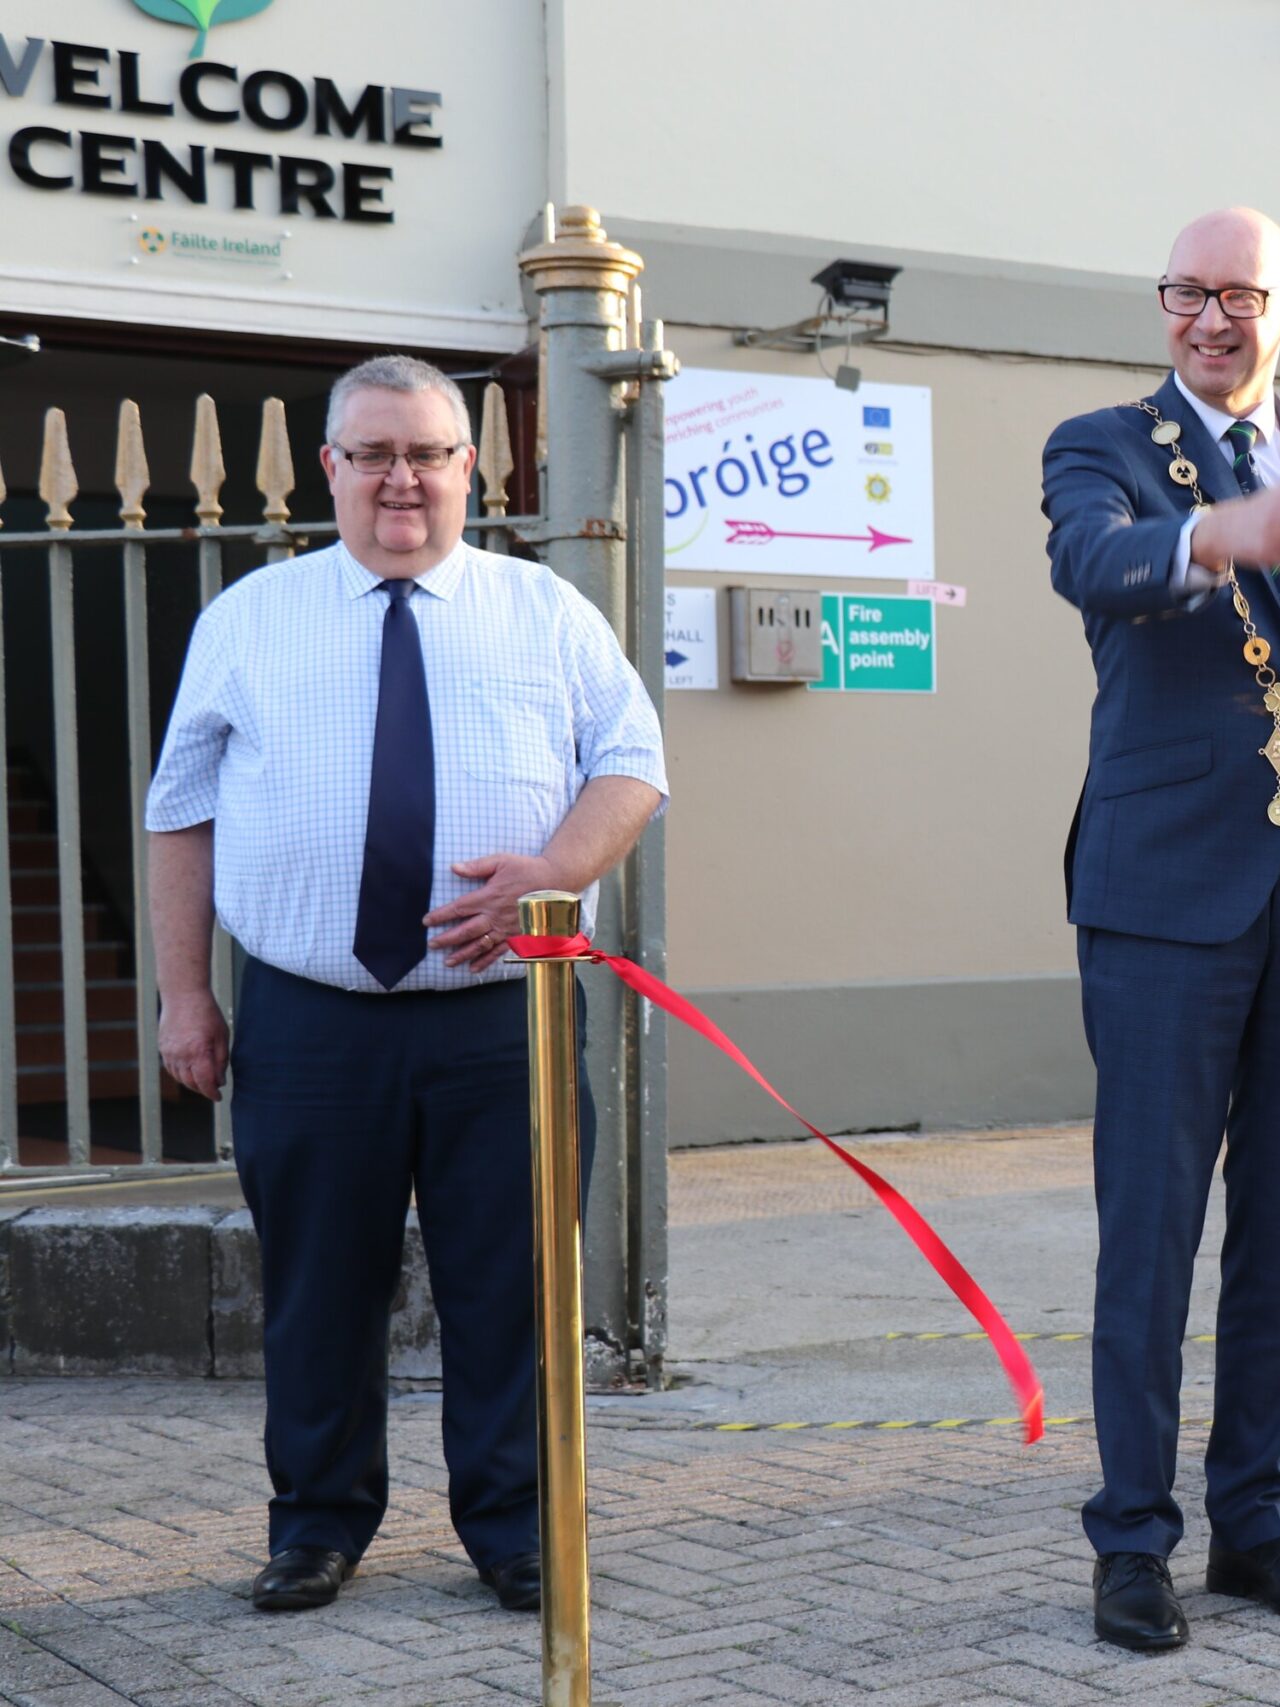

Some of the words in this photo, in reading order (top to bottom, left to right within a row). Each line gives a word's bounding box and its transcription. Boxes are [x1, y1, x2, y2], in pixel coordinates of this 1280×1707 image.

[8, 125, 395, 224] CENTRE
[223, 236, 281, 257] Ireland
[727, 386, 758, 408] youth
[665, 421, 715, 443] nriching
[716, 398, 784, 427] communities
[665, 428, 834, 518] oróige
[848, 604, 883, 623] Fire
[665, 629, 704, 643] HALL
[849, 628, 931, 651] assembly
[849, 650, 895, 671] point
[669, 675, 694, 686] LEFT
